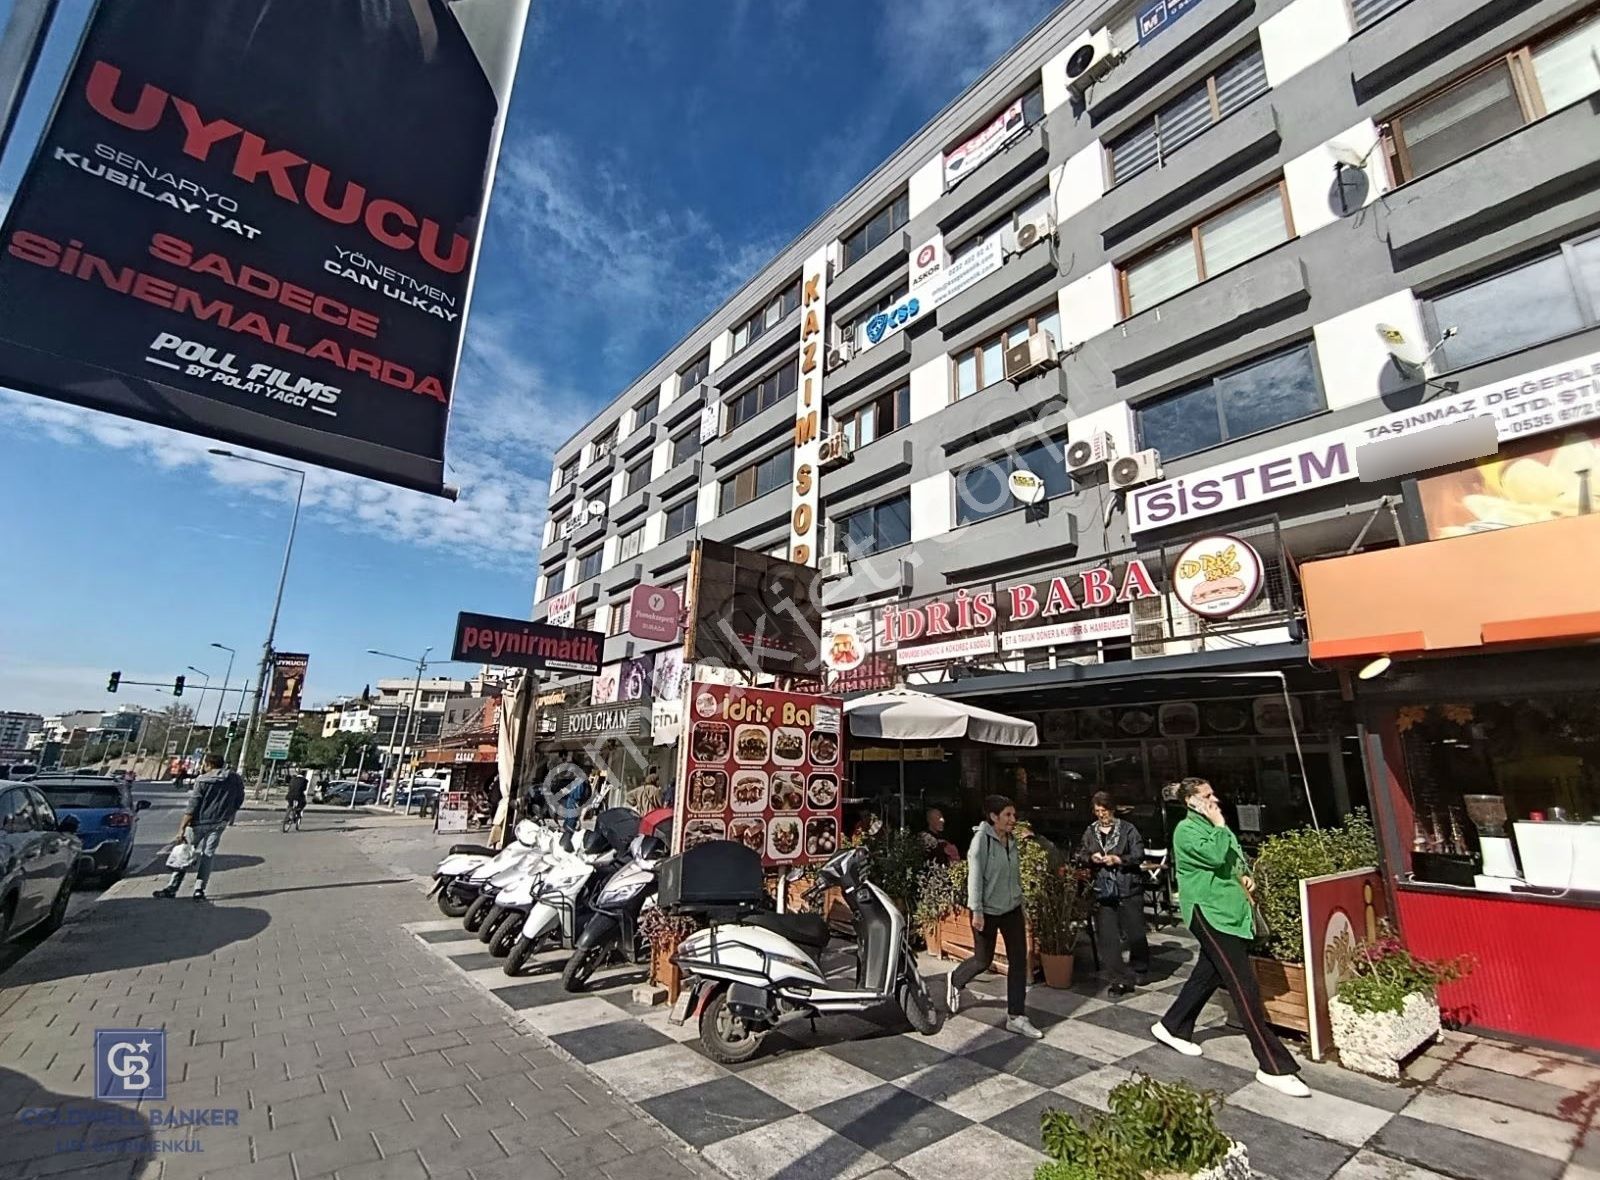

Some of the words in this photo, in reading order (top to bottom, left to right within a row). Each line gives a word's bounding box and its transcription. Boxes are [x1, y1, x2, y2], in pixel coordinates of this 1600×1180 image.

[55, 147, 201, 215] KUBİLAY
[206, 207, 262, 240] TAT
[85, 60, 470, 274] UYKUCU
[94, 143, 238, 213] SENARYO
[148, 232, 381, 339] SADECE
[323, 260, 379, 292] CAN
[383, 284, 459, 323] ULKAY
[334, 245, 456, 306] YÖNETMEN
[913, 264, 940, 285] ASKOR
[8, 229, 448, 404] SİNEMALARDA
[888, 298, 920, 329] KSS
[150, 332, 239, 374] POLL
[246, 363, 342, 404] FILMS
[185, 364, 208, 379] BY
[211, 372, 264, 394] POLAT
[795, 273, 820, 449] KAZIM
[1365, 398, 1476, 440] TAŞINMAZ
[1147, 442, 1350, 523] SİSTEM
[881, 589, 997, 644] İDRİS
[1008, 559, 1160, 623] BABA
[1090, 618, 1129, 633] HAMBURGER
[462, 624, 600, 663] peynirmatik
[568, 713, 592, 733] FOTO
